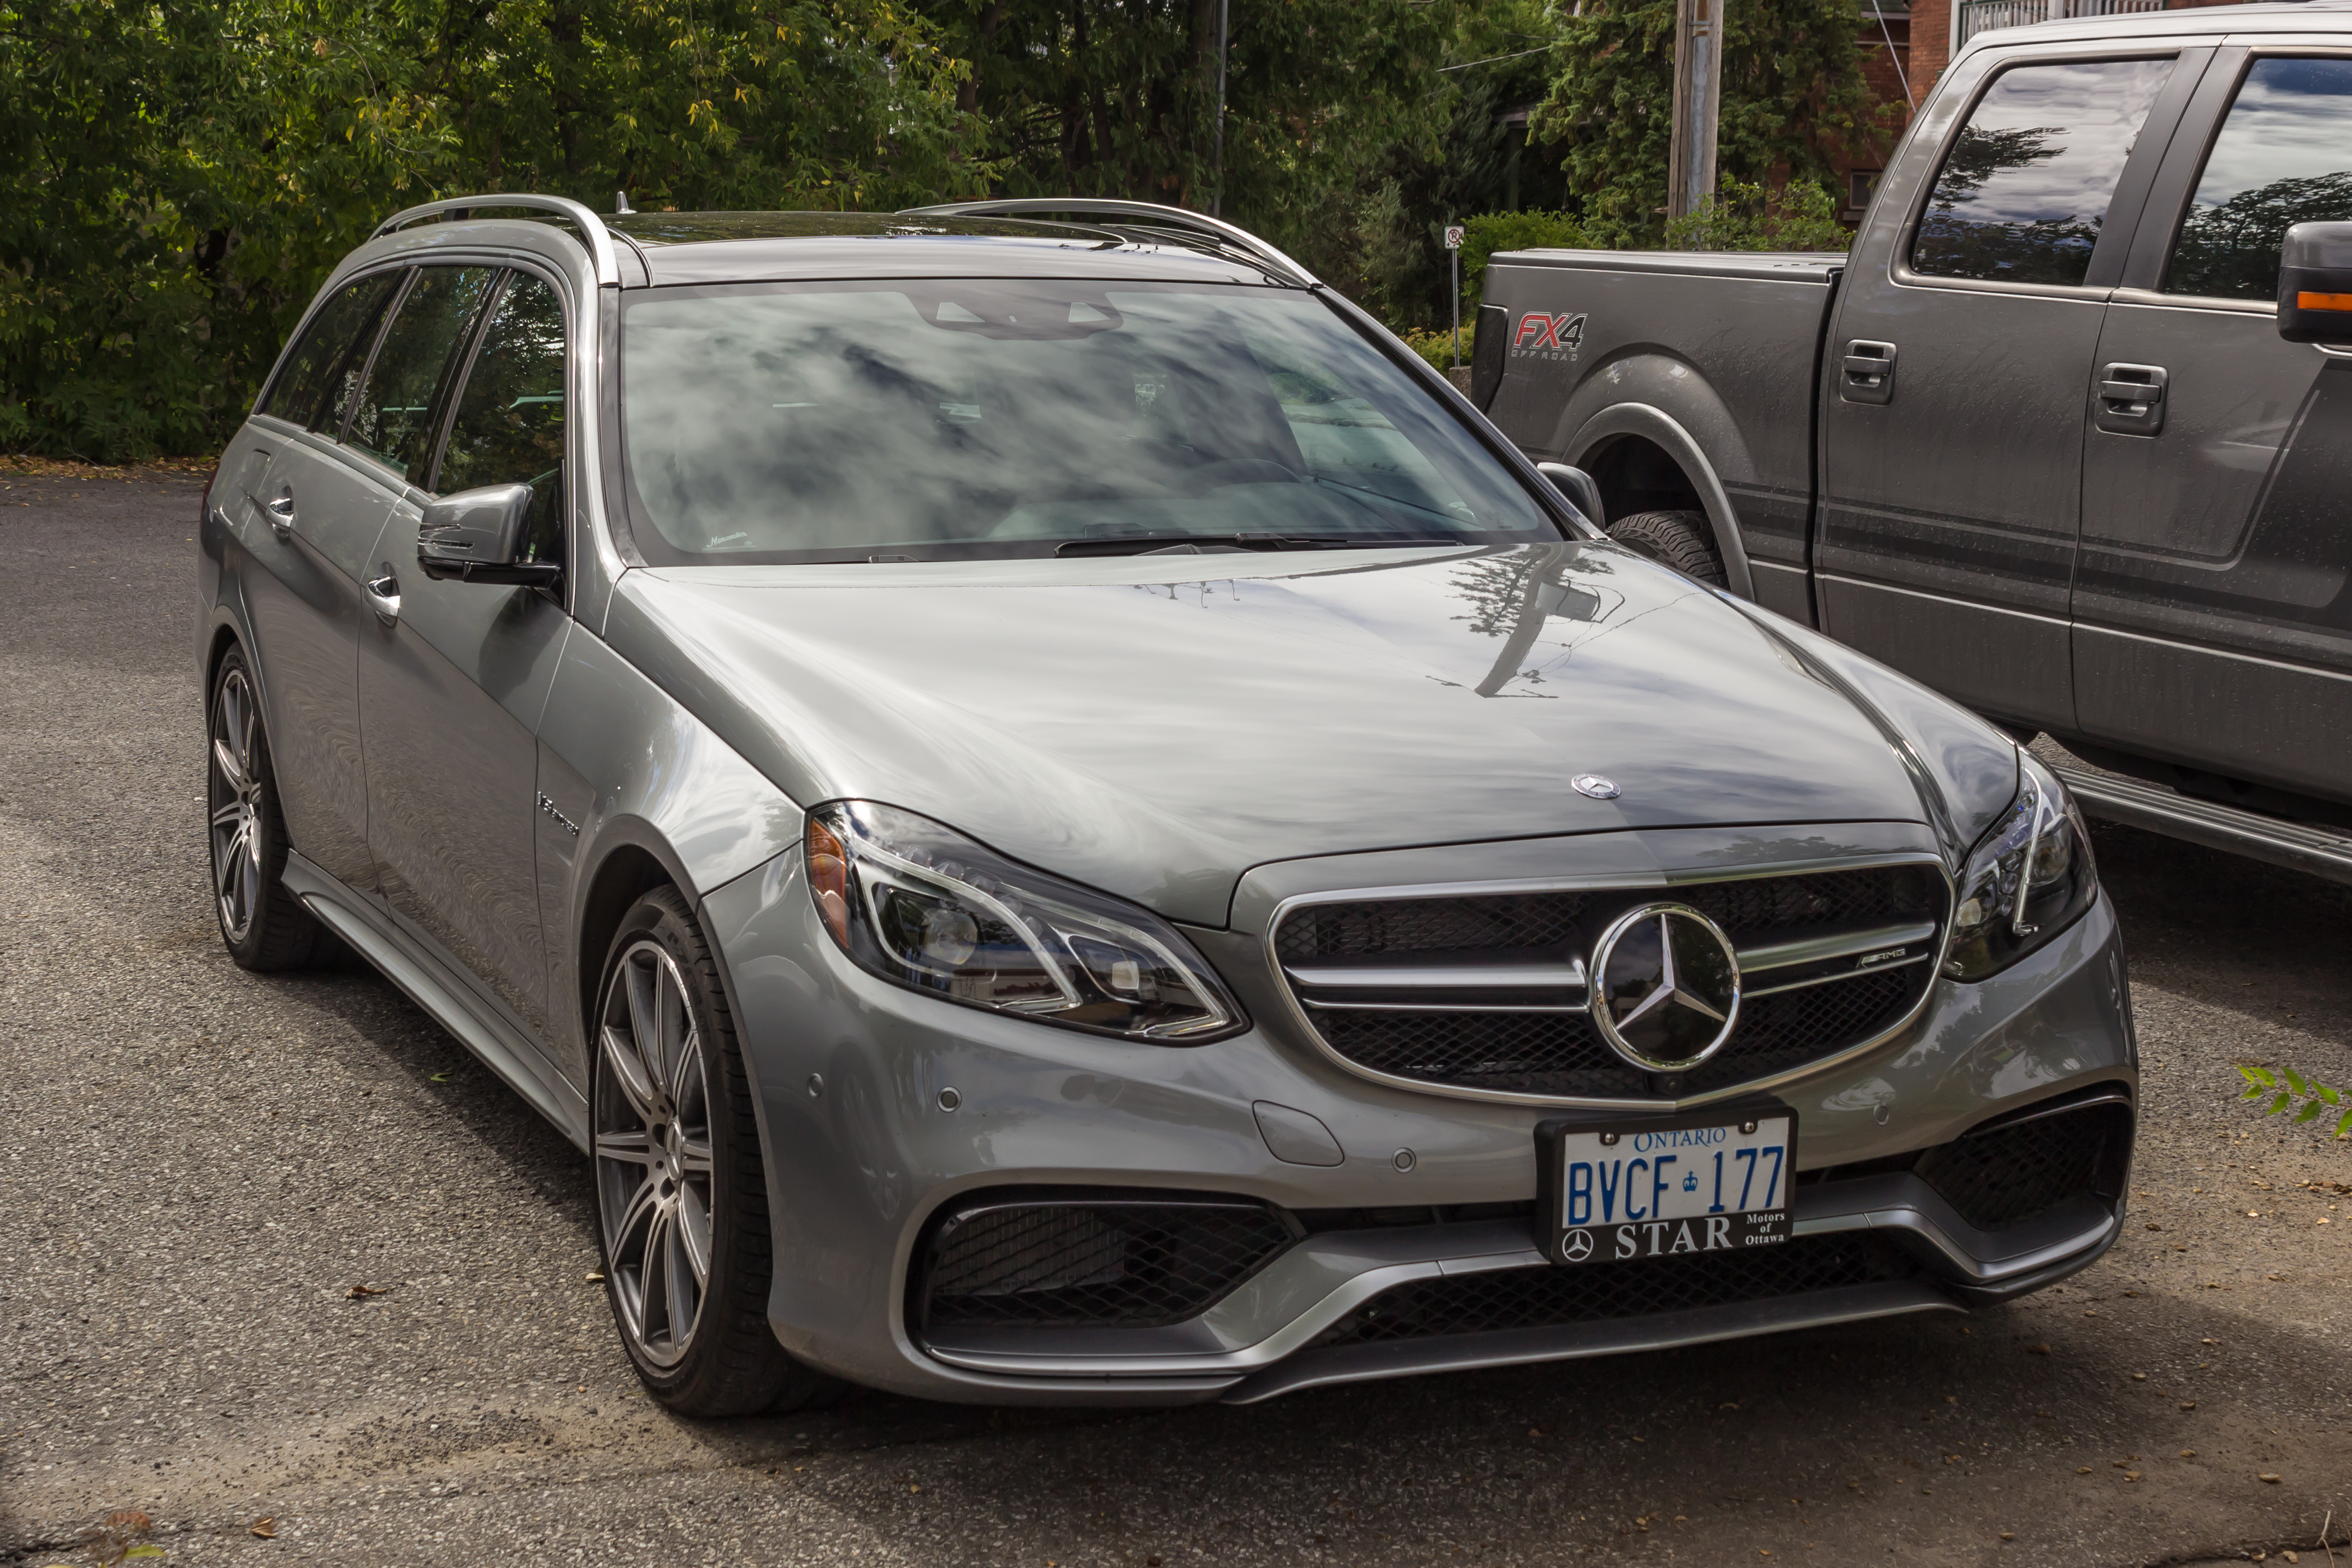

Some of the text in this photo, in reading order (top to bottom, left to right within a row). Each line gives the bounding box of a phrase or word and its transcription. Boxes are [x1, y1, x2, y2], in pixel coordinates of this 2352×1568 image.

[1513, 311, 1588, 351] FX4
[1511, 350, 1578, 362] OFF ROAD
[707, 532, 747, 547] Mercedes
[1876, 948, 1906, 960] AMG
[1634, 1127, 1726, 1152] ONTARIO
[1568, 1146, 1784, 1225] BVCF 177
[1747, 1212, 1785, 1224] Motors
[1760, 1223, 1771, 1233] of
[1616, 1216, 1733, 1259] STAR
[1745, 1233, 1784, 1245] Ottawa
